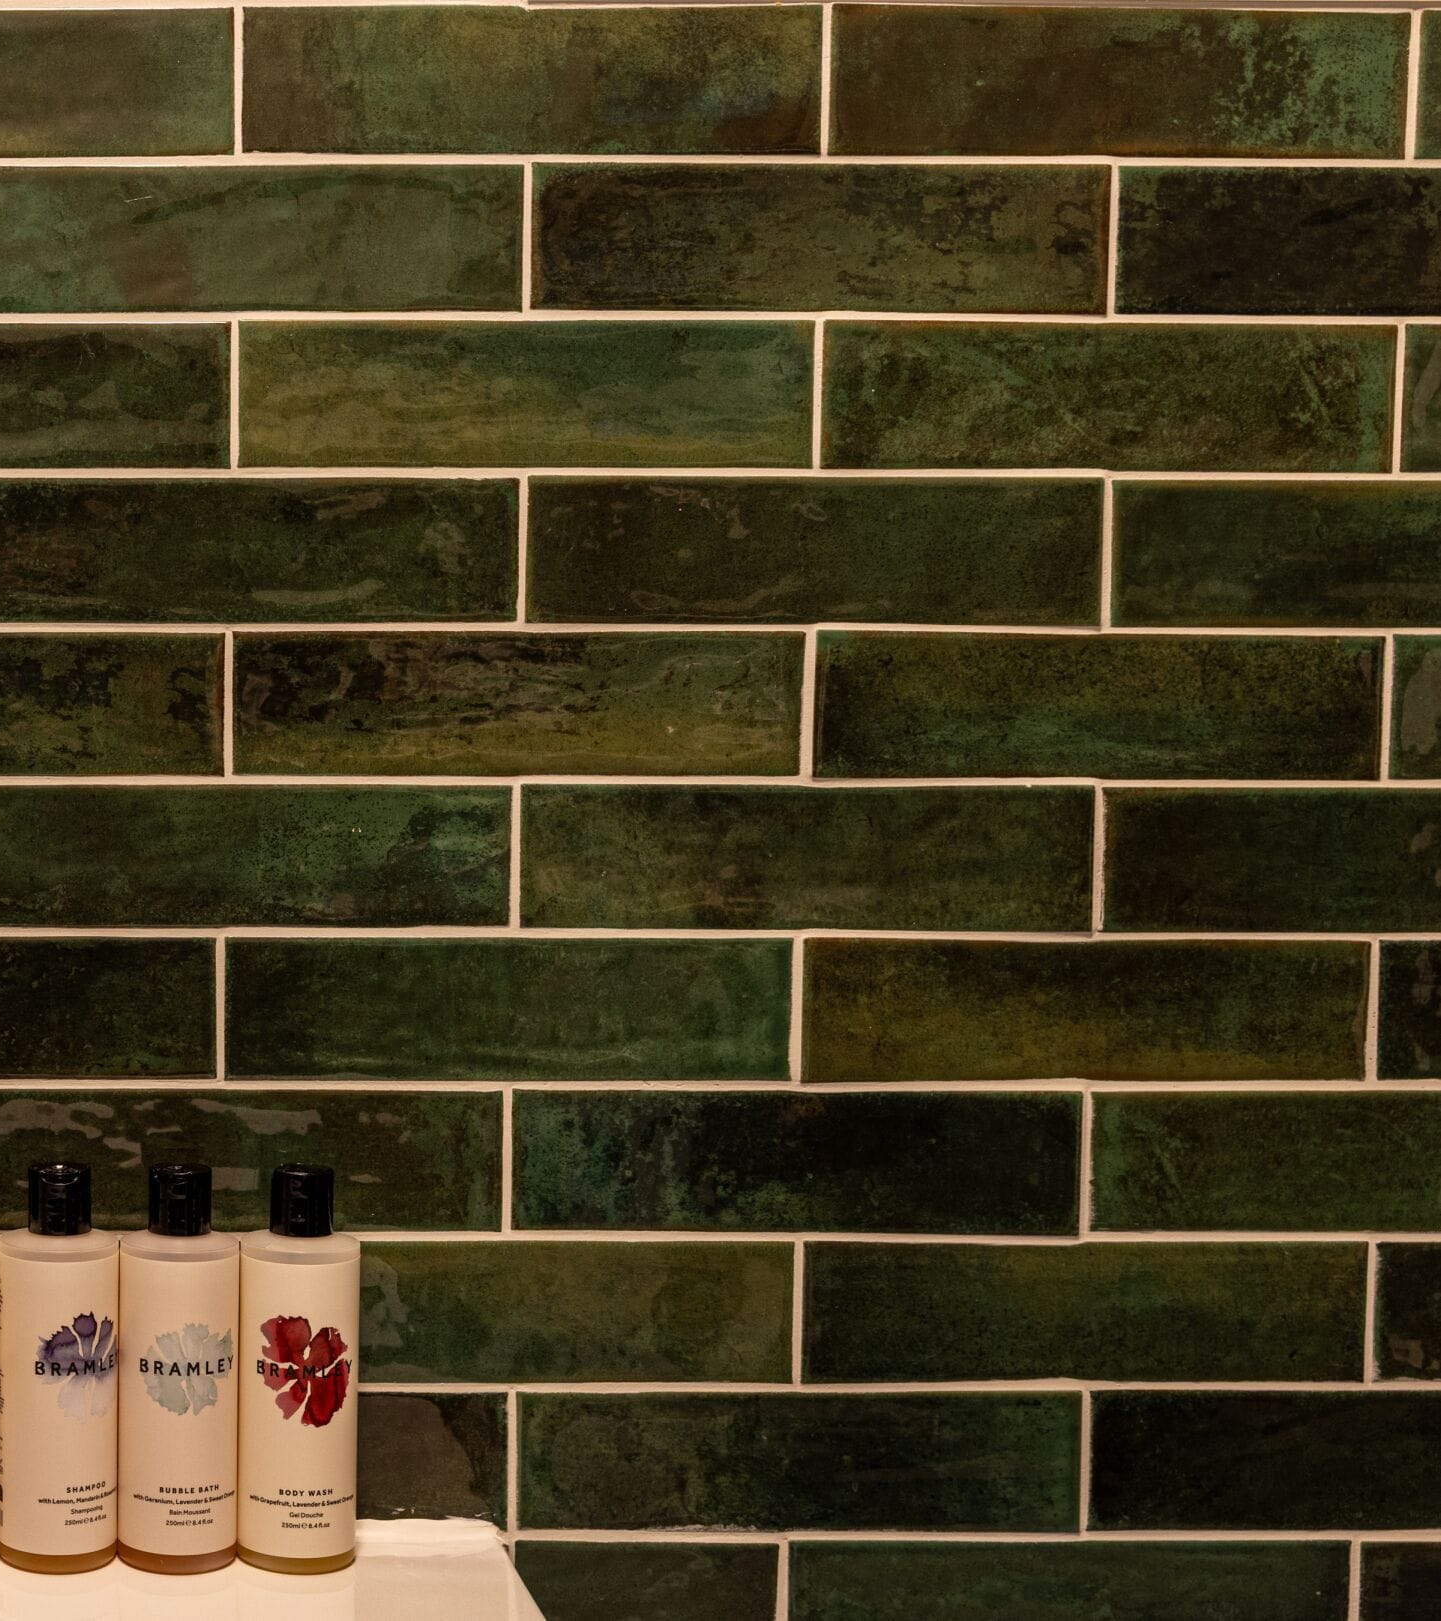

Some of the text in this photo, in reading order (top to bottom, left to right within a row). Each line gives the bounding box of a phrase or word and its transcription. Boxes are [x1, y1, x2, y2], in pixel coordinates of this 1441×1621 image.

[139, 1355, 233, 1377] BRAMLEY
[256, 1359, 352, 1380] BRAMLEY
[66, 1481, 106, 1493] SHAMPOO
[159, 1484, 219, 1494] BUBBLE BATH
[279, 1488, 333, 1496] BODY WASH
[76, 1495, 101, 1503] Mandarin
[144, 1496, 175, 1505] Geranium,
[260, 1497, 292, 1507] Grapefruit,
[71, 1505, 103, 1514] Shampooing
[183, 1508, 211, 1516] Moussant
